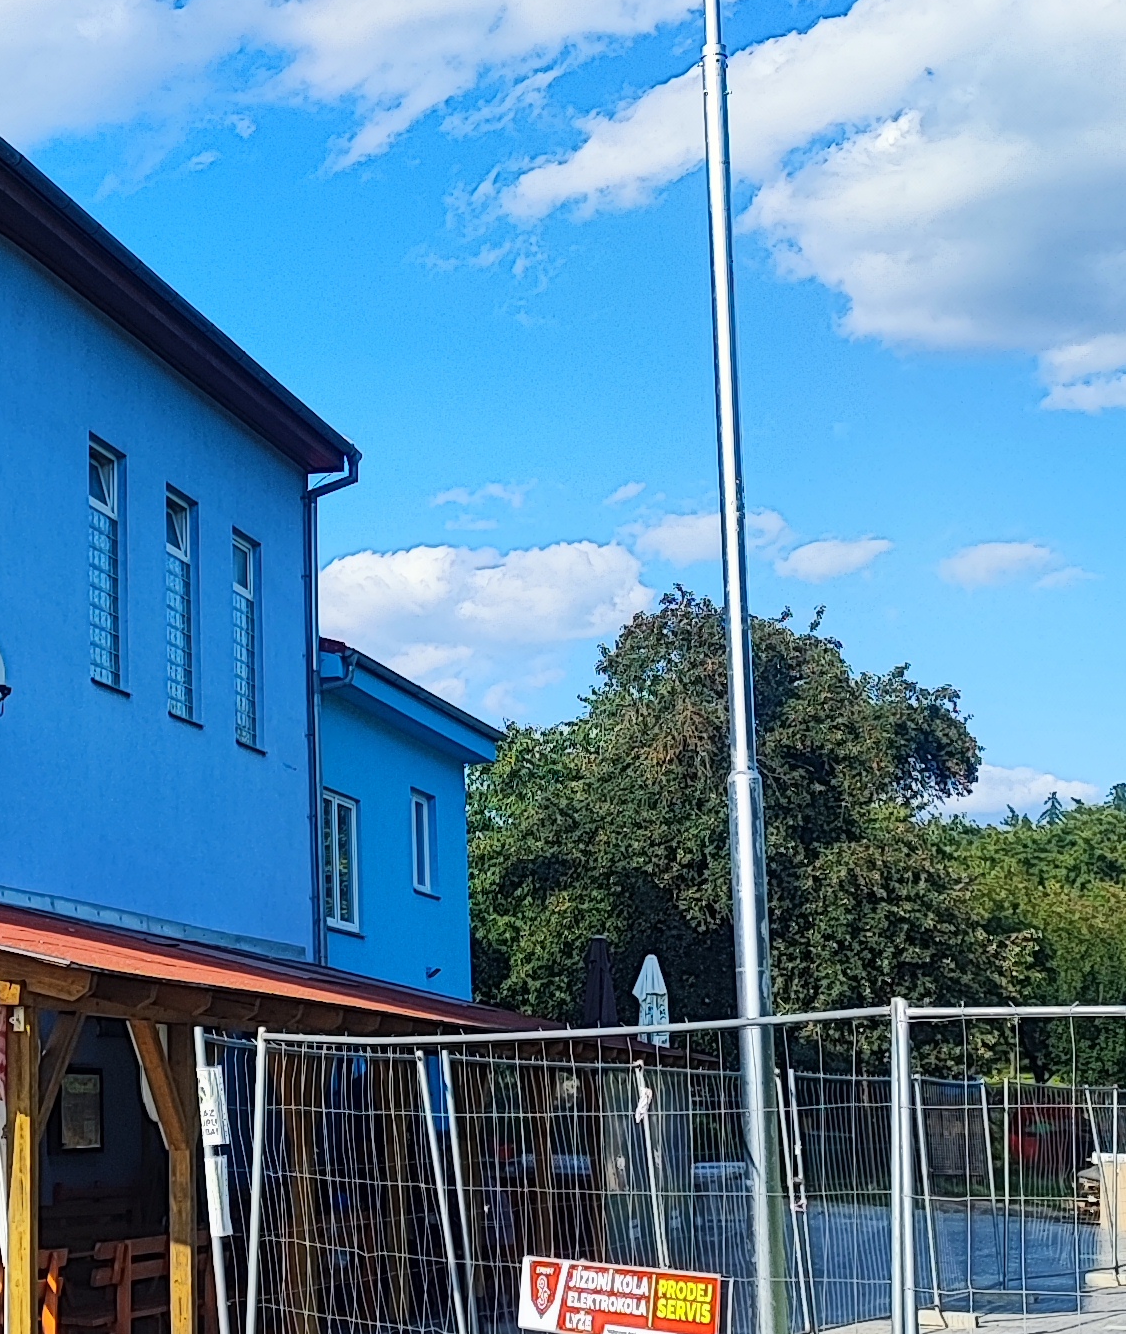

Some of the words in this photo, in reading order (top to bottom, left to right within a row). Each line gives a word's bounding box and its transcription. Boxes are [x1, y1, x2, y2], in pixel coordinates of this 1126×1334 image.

[568, 1265, 613, 1292] JÍZDNÍ
[614, 1272, 649, 1297] KOLA
[657, 1278, 713, 1303] PRODEJ
[566, 1290, 647, 1317] ELEKTROKOLA
[656, 1298, 712, 1324] SERVIS
[565, 1310, 593, 1332] LYŽE
